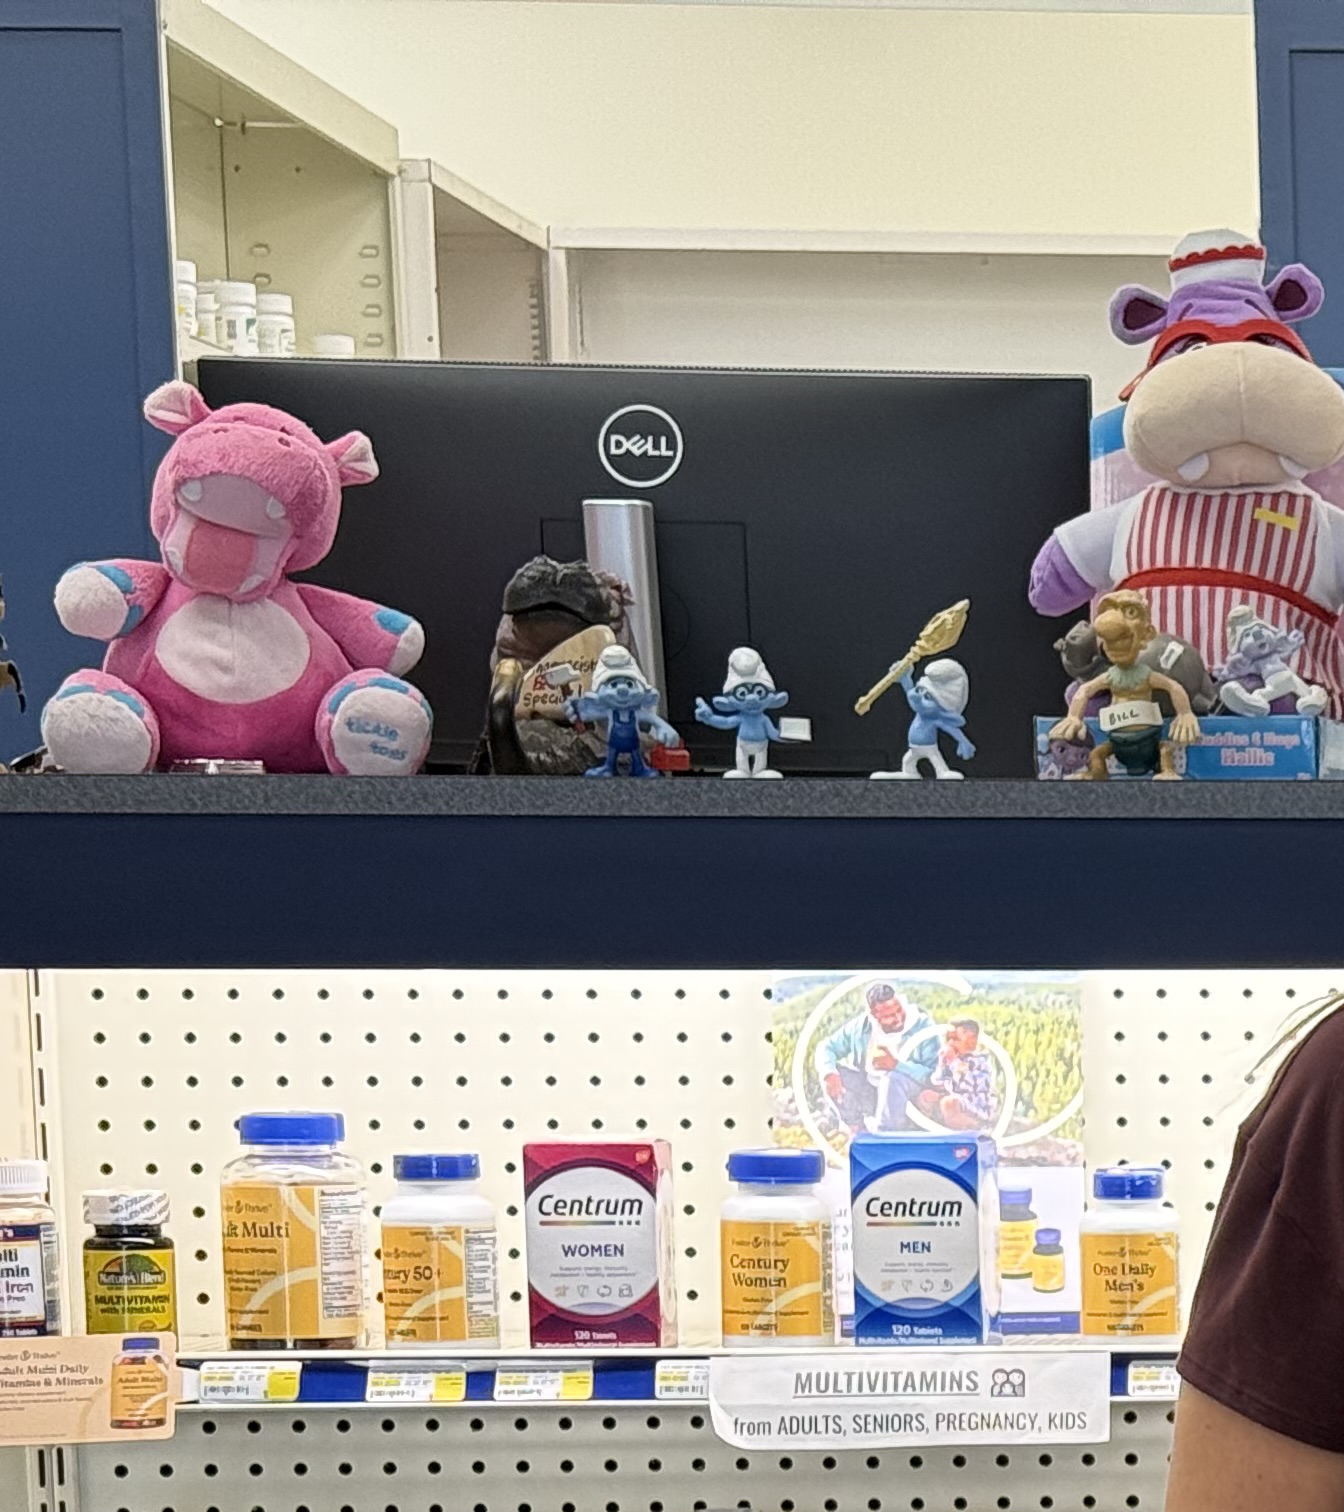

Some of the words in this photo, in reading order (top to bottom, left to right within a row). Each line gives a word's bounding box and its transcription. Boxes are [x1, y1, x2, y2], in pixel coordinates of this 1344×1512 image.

[609, 433, 674, 457] DELL
[1108, 708, 1141, 726] BILL
[1220, 748, 1275, 766] Hallie
[537, 1194, 643, 1217] Centrum
[865, 1197, 962, 1217] Centrum
[242, 1221, 290, 1239] Multi
[561, 1243, 625, 1258] WOMEN
[900, 1242, 932, 1254] MEN
[729, 1254, 790, 1272] Century
[1092, 1262, 1119, 1276] One
[731, 1272, 787, 1288] Women
[794, 1370, 980, 1394] MULTIVITAMINS
[734, 1417, 772, 1436] from
[777, 1414, 847, 1438] ADULTS,
[852, 1413, 929, 1435] SENIORS,
[935, 1412, 1042, 1434] PREGNANCY,
[1047, 1411, 1087, 1430] KIDS
